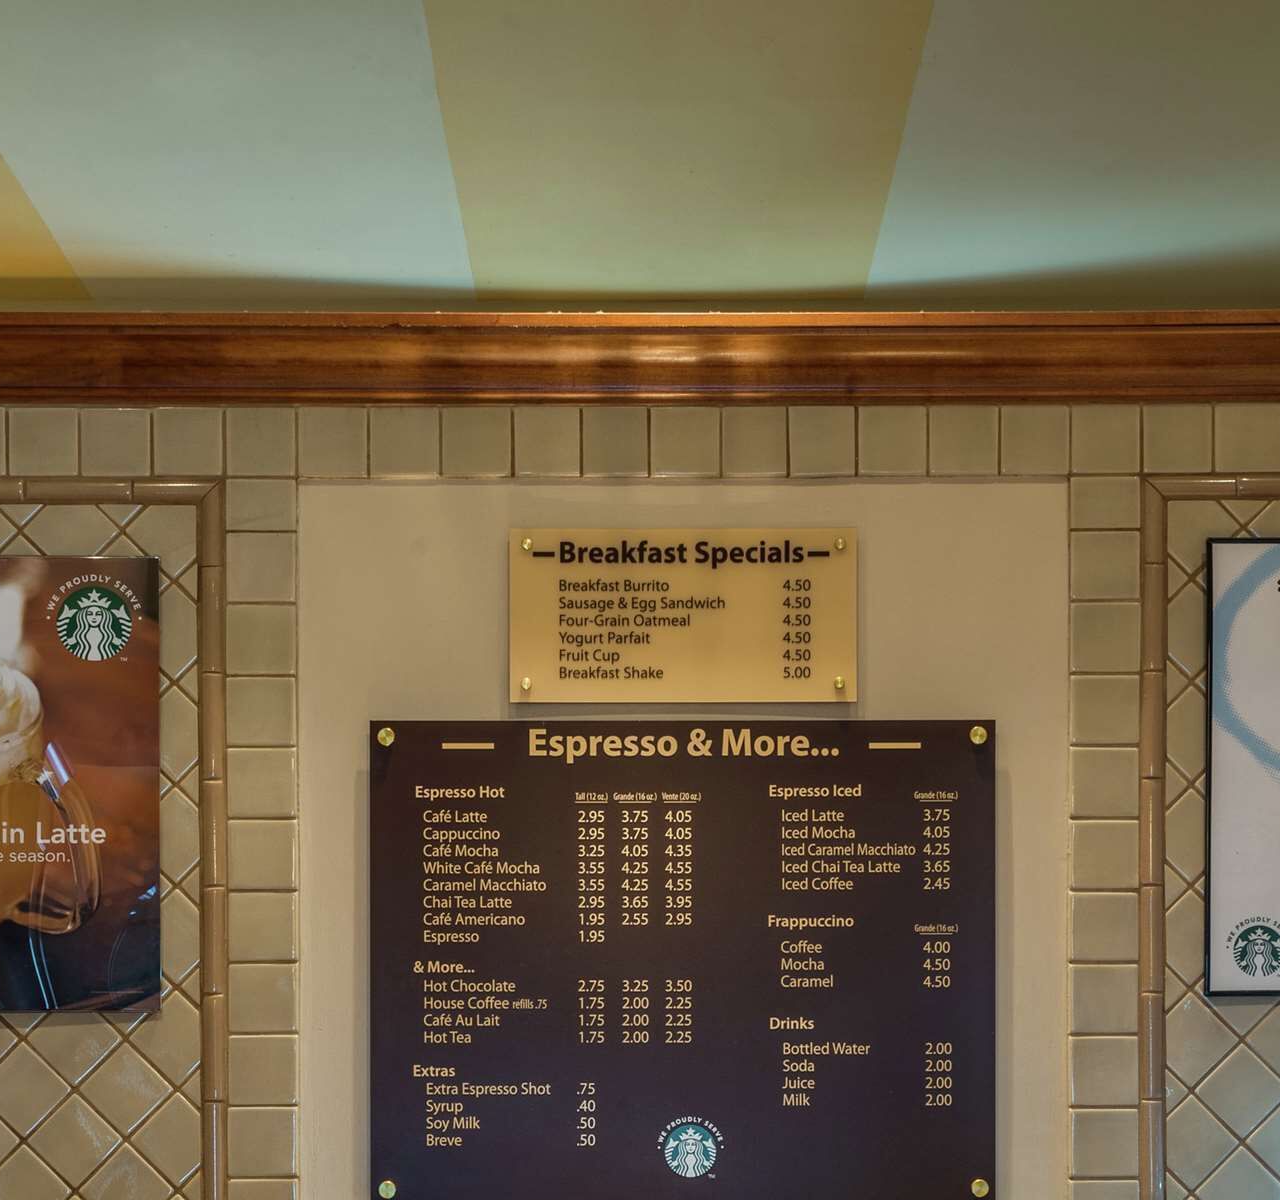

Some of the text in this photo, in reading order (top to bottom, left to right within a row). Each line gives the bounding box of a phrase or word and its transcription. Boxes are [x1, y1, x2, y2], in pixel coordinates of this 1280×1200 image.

[559, 539, 805, 570] Breakfast Specials
[47, 574, 142, 611] WE PROUDLY SERVE
[558, 578, 812, 593] Breakfast Burrito 4.50
[558, 595, 812, 614] Sausage & Egg Sandwich 4.50
[558, 611, 812, 628] Four-Grain Oatmeal 4.50
[558, 630, 812, 648] Yogurt Parfait 4.50
[559, 648, 812, 666] Fruit Cup 4.50
[559, 663, 812, 680] Breakfast Shake 5.00
[528, 728, 840, 764] Espresso & More...
[415, 785, 505, 802] Espresso Hot
[768, 783, 862, 801] Espresso Iced
[423, 809, 692, 823] Café Latte 2.95 3.75 4.05
[36, 821, 107, 845] Latte
[8, 852, 71, 864] season.
[423, 878, 693, 892] Caramel Macchiato 3.55 4.25 4.55
[767, 914, 855, 931] Frappuccino
[780, 939, 951, 954] Coffee 4.00
[413, 960, 475, 974] & More...
[769, 1016, 815, 1030] Drinks
[782, 1041, 953, 1055] Bottled Water 2.00
[413, 1064, 456, 1078] Extras
[426, 1081, 596, 1098] Extra Espresso Shot .75
[782, 1092, 953, 1107] Milk 2.00
[657, 1116, 723, 1143] WE PROUDLY SERVE
